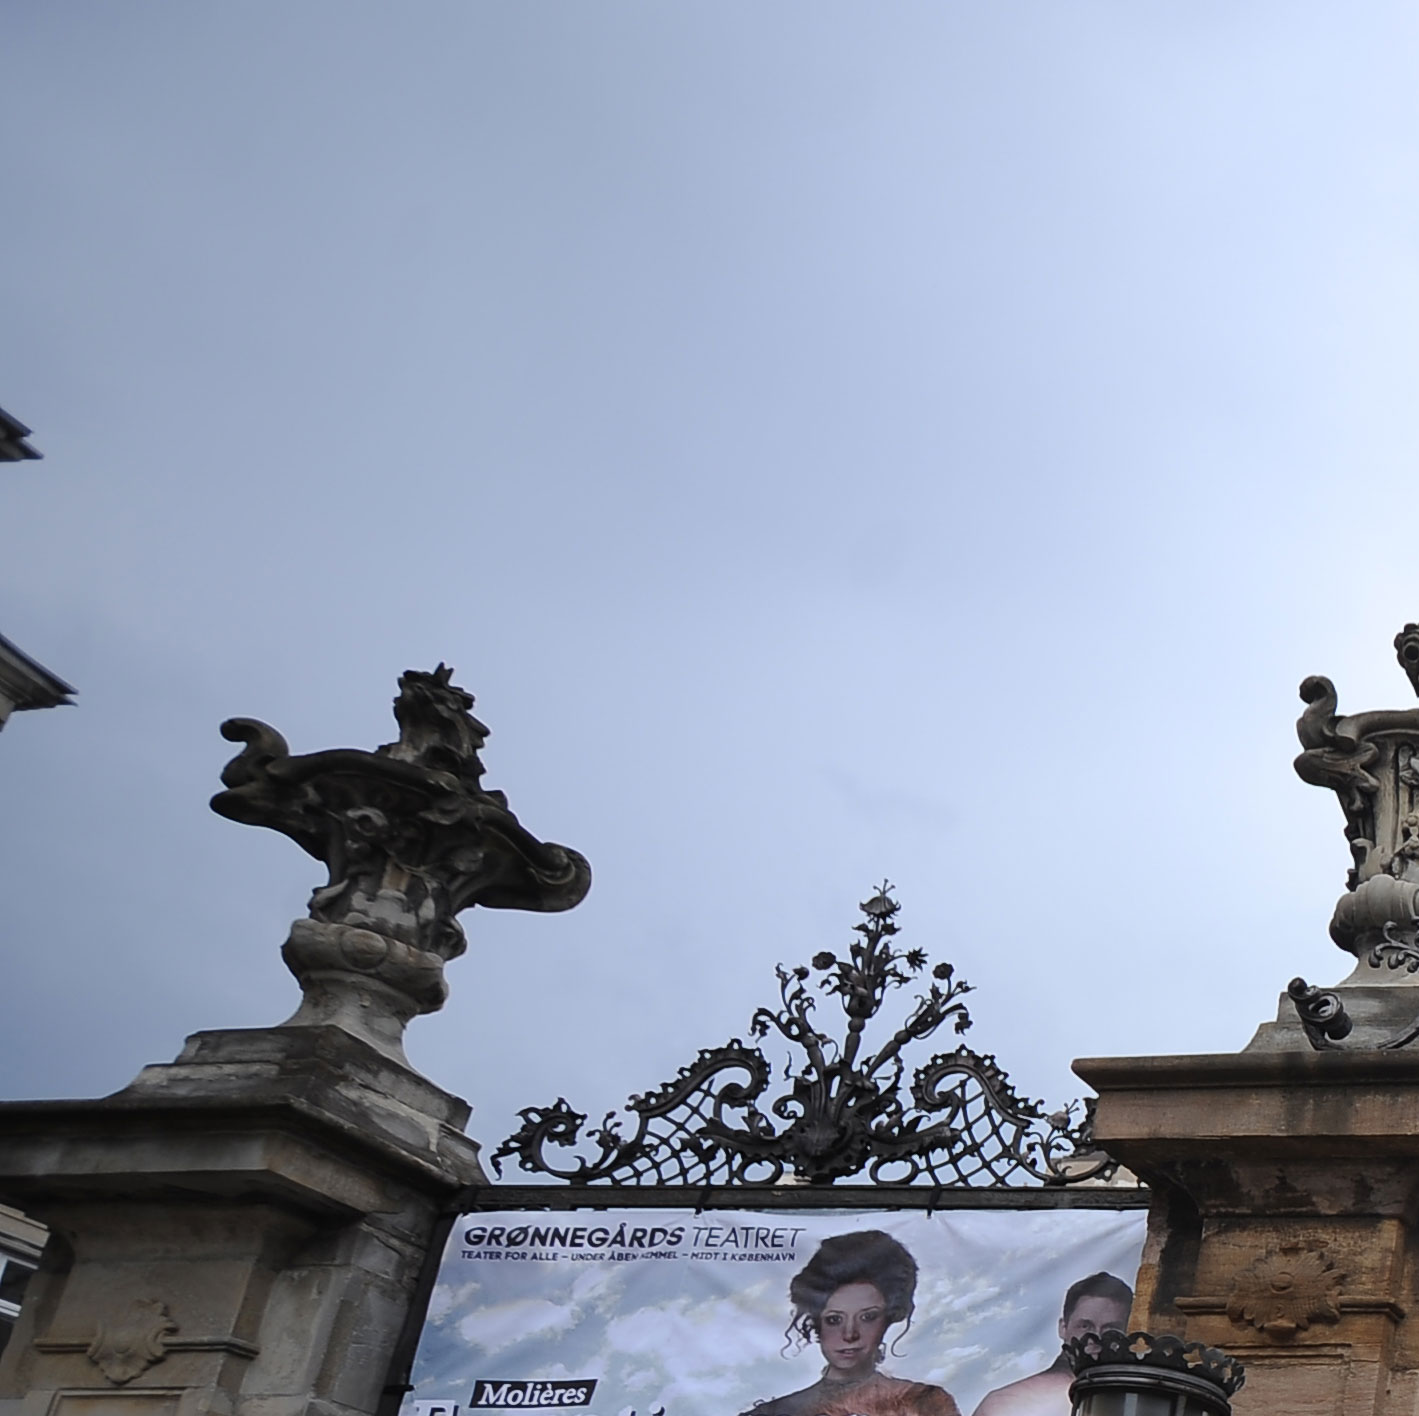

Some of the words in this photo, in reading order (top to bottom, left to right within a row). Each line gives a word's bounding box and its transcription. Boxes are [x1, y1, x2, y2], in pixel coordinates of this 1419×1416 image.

[463, 1222, 685, 1248] GRØNNEGÅRDS
[691, 1226, 806, 1248] TEATRET
[461, 1250, 502, 1260] TEATER
[504, 1251, 528, 1261] FOR
[531, 1252, 559, 1261] ALLE
[571, 1252, 605, 1261] UNDER
[608, 1250, 639, 1262] ÅBEN
[690, 1251, 719, 1261] MIDT
[731, 1252, 796, 1261] KØBENHAVN
[477, 1382, 588, 1407] Molières
